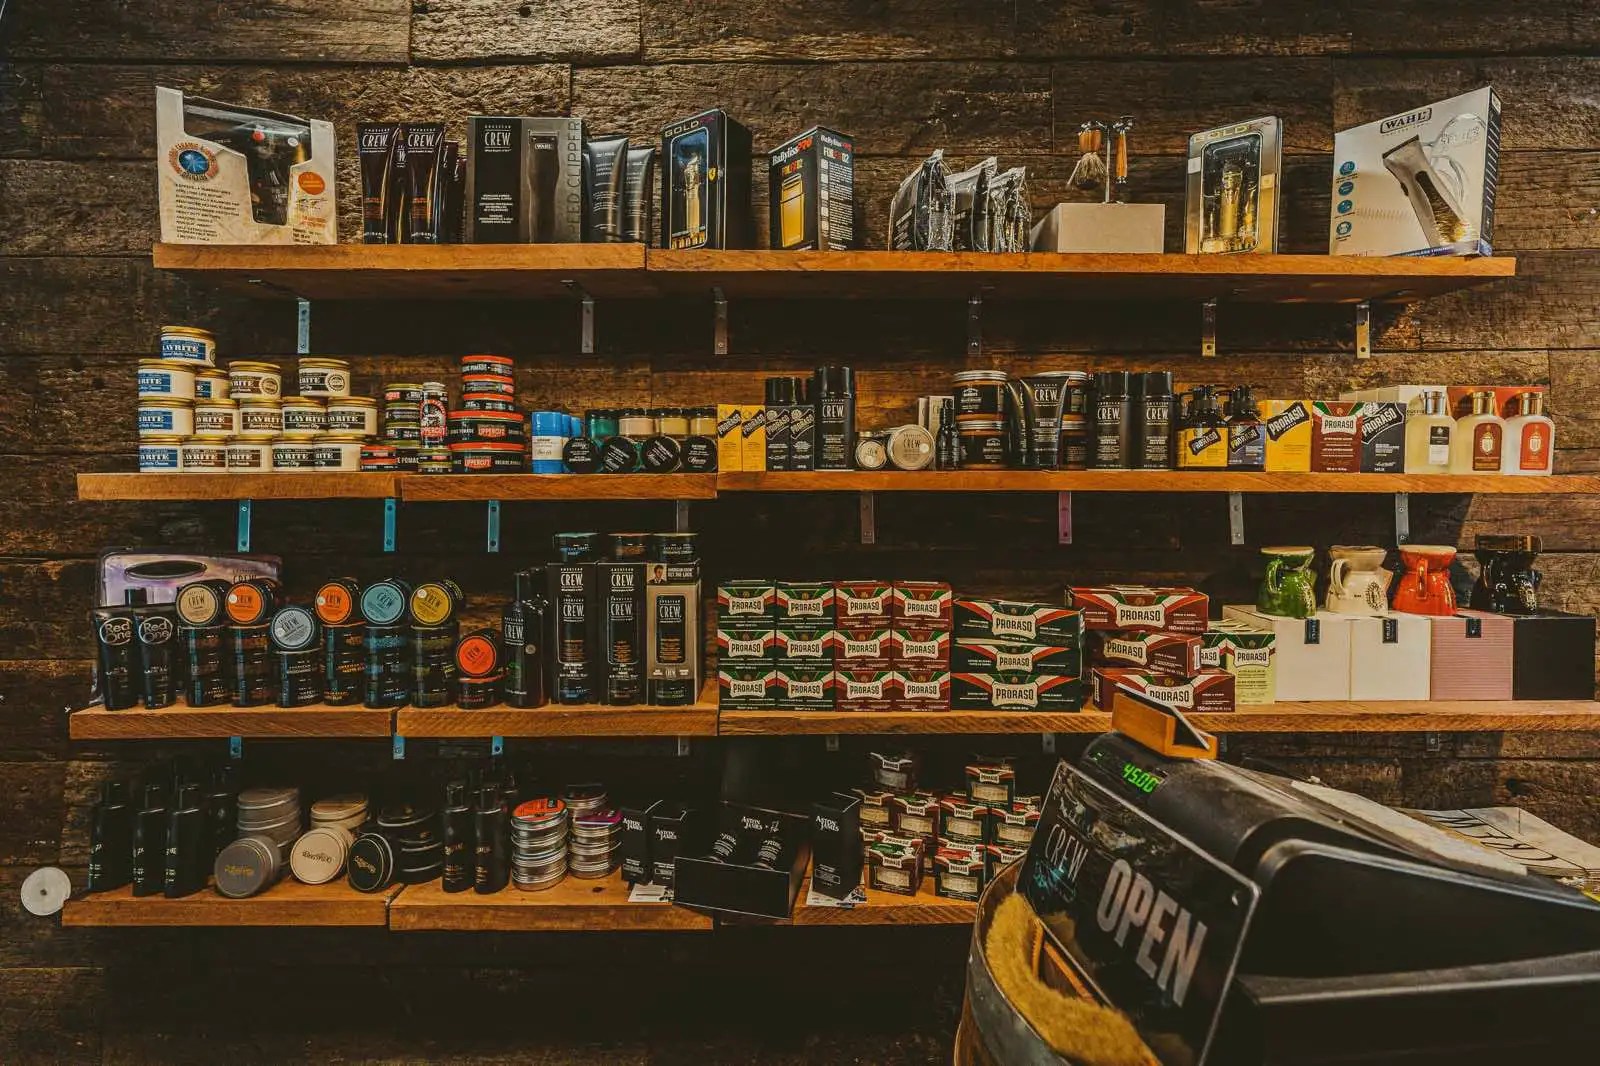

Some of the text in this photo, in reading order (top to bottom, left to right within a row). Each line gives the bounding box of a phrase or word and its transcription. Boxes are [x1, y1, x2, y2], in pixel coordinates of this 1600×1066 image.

[1385, 110, 1429, 129] WAHL
[362, 134, 388, 147] CREW
[407, 134, 435, 147] CREW
[484, 131, 511, 146] CREW
[1034, 389, 1058, 402] CREW
[822, 405, 844, 418] CREW
[1097, 407, 1120, 419] CREW
[1146, 407, 1168, 419] CREW
[1269, 405, 1305, 435] PRORASO
[1324, 419, 1354, 429] PRORASO
[1361, 407, 1397, 437] PRORASO
[560, 573, 584, 587] CREW
[611, 574, 635, 587] CREW
[563, 604, 585, 617] CREW
[610, 603, 633, 616] CREW
[660, 605, 682, 618] CREW
[731, 601, 762, 611] PRORASO
[790, 602, 821, 612] PRORASO
[850, 601, 880, 612] PRORASO
[907, 602, 938, 613] PRORASO
[1120, 609, 1161, 622] PRORASO
[996, 617, 1033, 633] PRORASO
[504, 624, 525, 640] CREW
[731, 643, 761, 653] PRORASO
[790, 643, 820, 653] PRORASO
[847, 643, 878, 653] PRORASO
[905, 644, 936, 654] PRORASO
[1106, 640, 1143, 659] PRORASO
[999, 657, 1030, 667] PRORASO
[1200, 652, 1217, 661] RASO
[1237, 652, 1267, 662] PRORASO
[733, 683, 763, 694] PRORASO
[790, 684, 821, 694] PRORASO
[849, 684, 880, 695] PRORASO
[907, 685, 937, 695] PRORASO
[996, 688, 1034, 700] PRORASO
[1045, 824, 1089, 883] CREW
[1097, 858, 1208, 1008] OPEN
